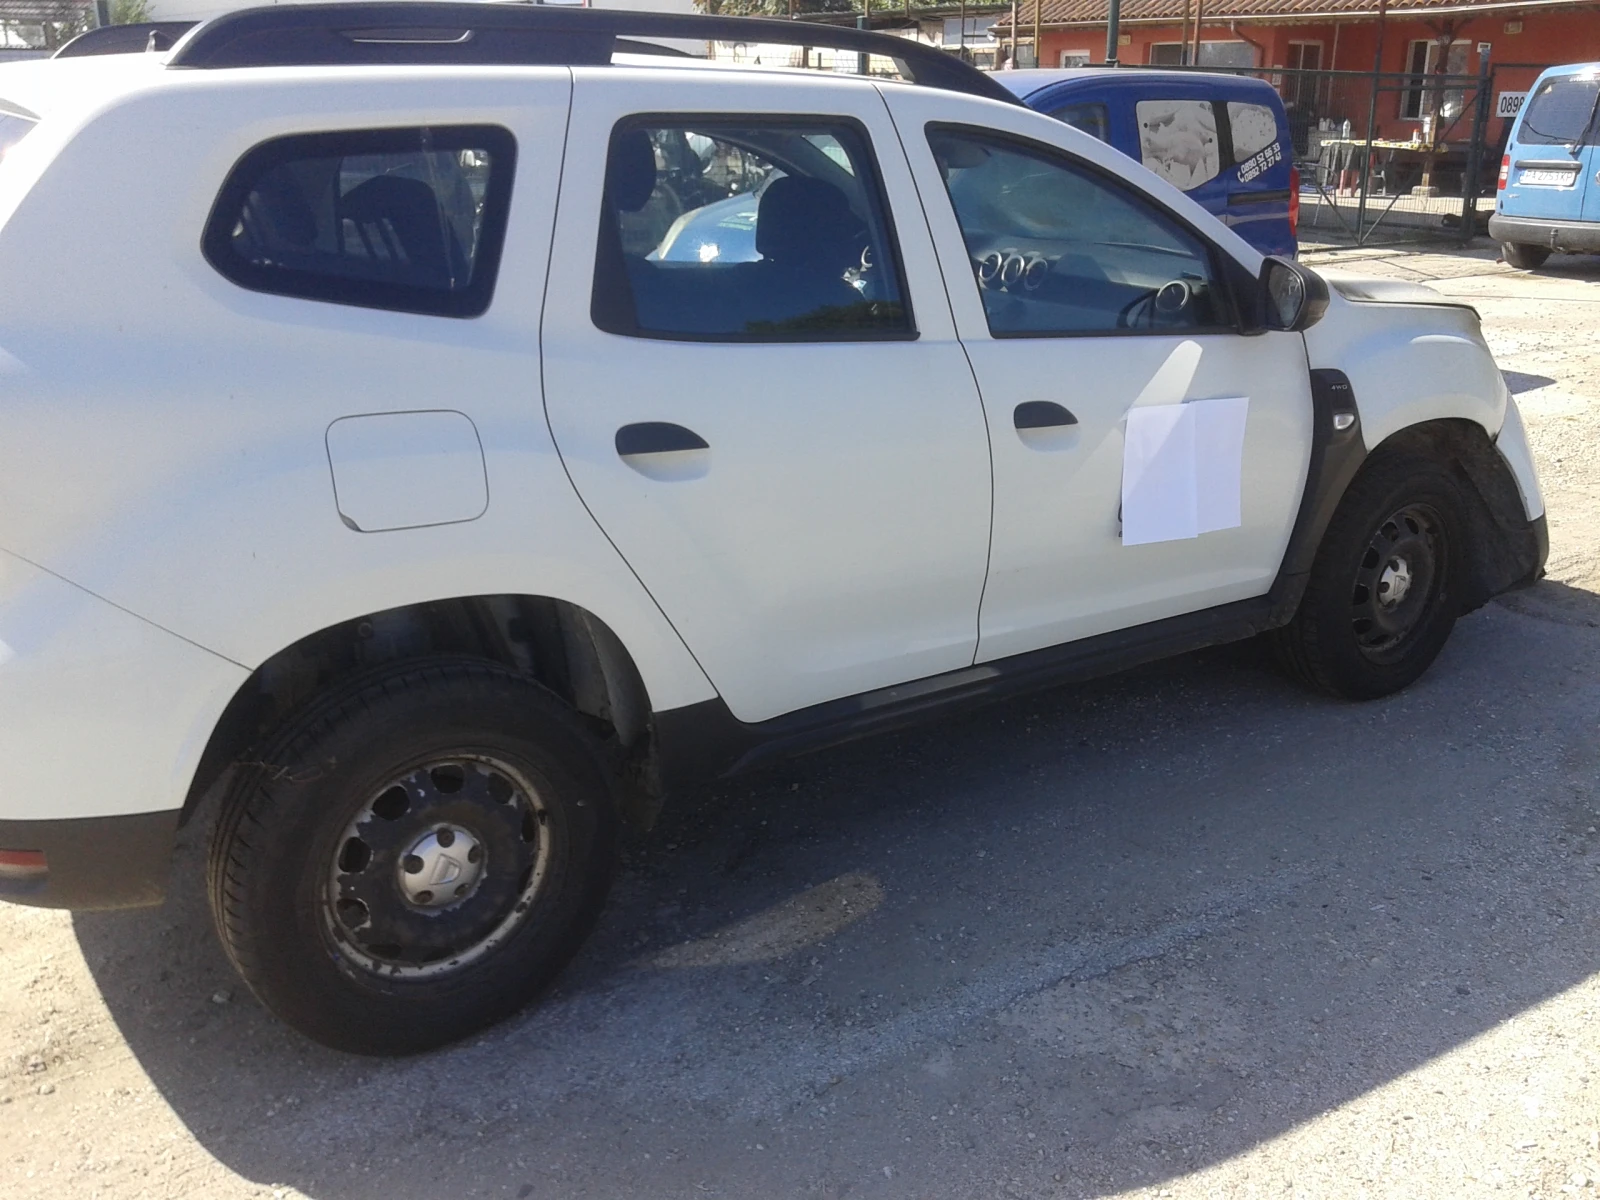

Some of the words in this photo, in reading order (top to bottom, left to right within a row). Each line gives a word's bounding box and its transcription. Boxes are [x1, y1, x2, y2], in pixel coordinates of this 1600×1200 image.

[1256, 152, 1265, 163] 52
[1272, 142, 1281, 153] 33
[1260, 162, 1268, 172] 72
